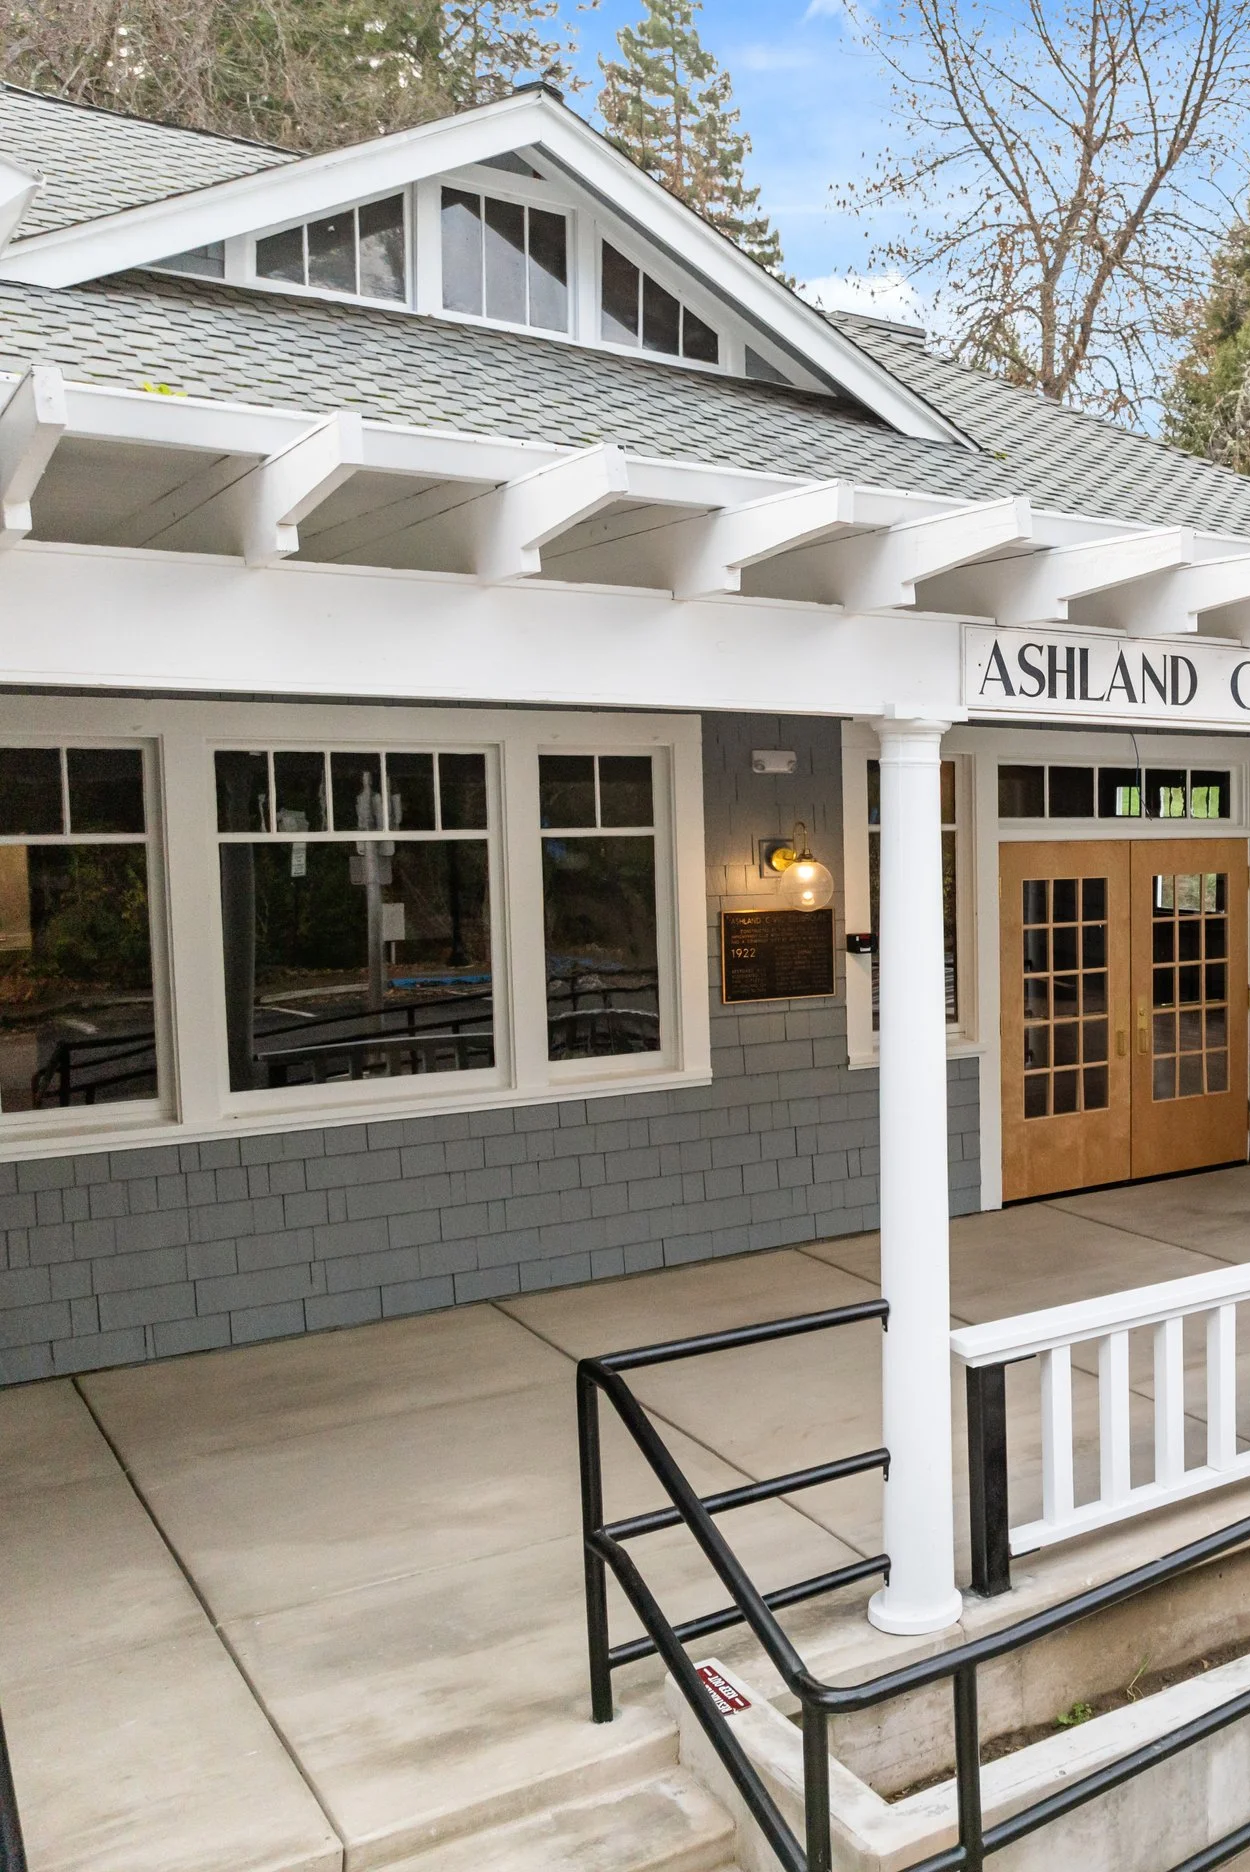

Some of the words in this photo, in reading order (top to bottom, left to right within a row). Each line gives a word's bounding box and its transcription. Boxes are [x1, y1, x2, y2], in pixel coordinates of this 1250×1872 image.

[979, 639, 1198, 706] ASHLAND
[731, 947, 756, 959] 1922
[707, 1675, 725, 1688] OUT
[718, 1685, 739, 1700] KEEP
